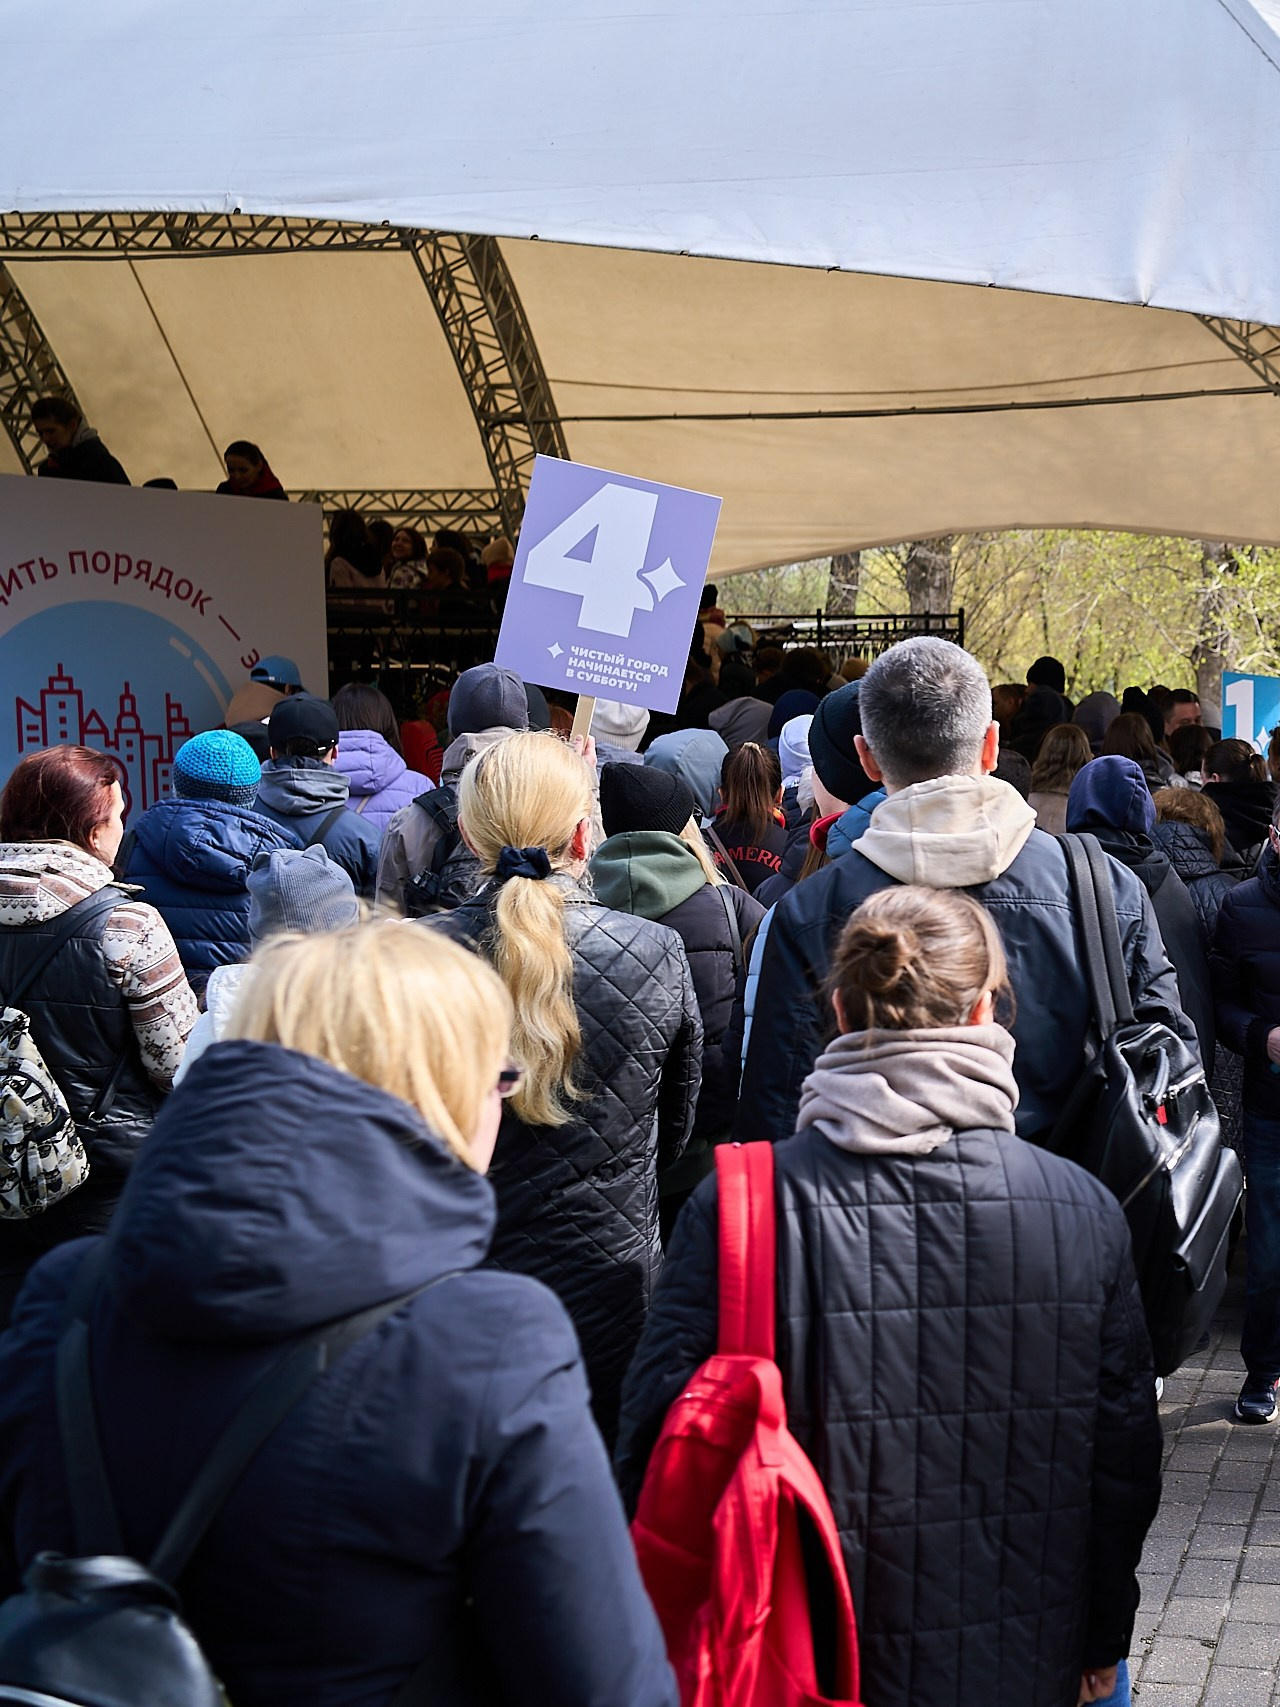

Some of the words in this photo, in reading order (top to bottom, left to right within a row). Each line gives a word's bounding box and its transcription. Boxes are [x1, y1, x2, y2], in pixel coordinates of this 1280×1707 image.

[0, 557, 59, 606] ИТЬ
[68, 550, 213, 616] порядок
[523, 483, 659, 638] 4
[565, 668, 575, 678] В
[576, 671, 638, 692] СУББОТУ!
[568, 657, 652, 684] НАЧИНАЕТСЯ
[570, 645, 625, 666] ЧИСТЫЙ
[627, 658, 669, 678] ГОРОД
[1225, 679, 1262, 756] 1
